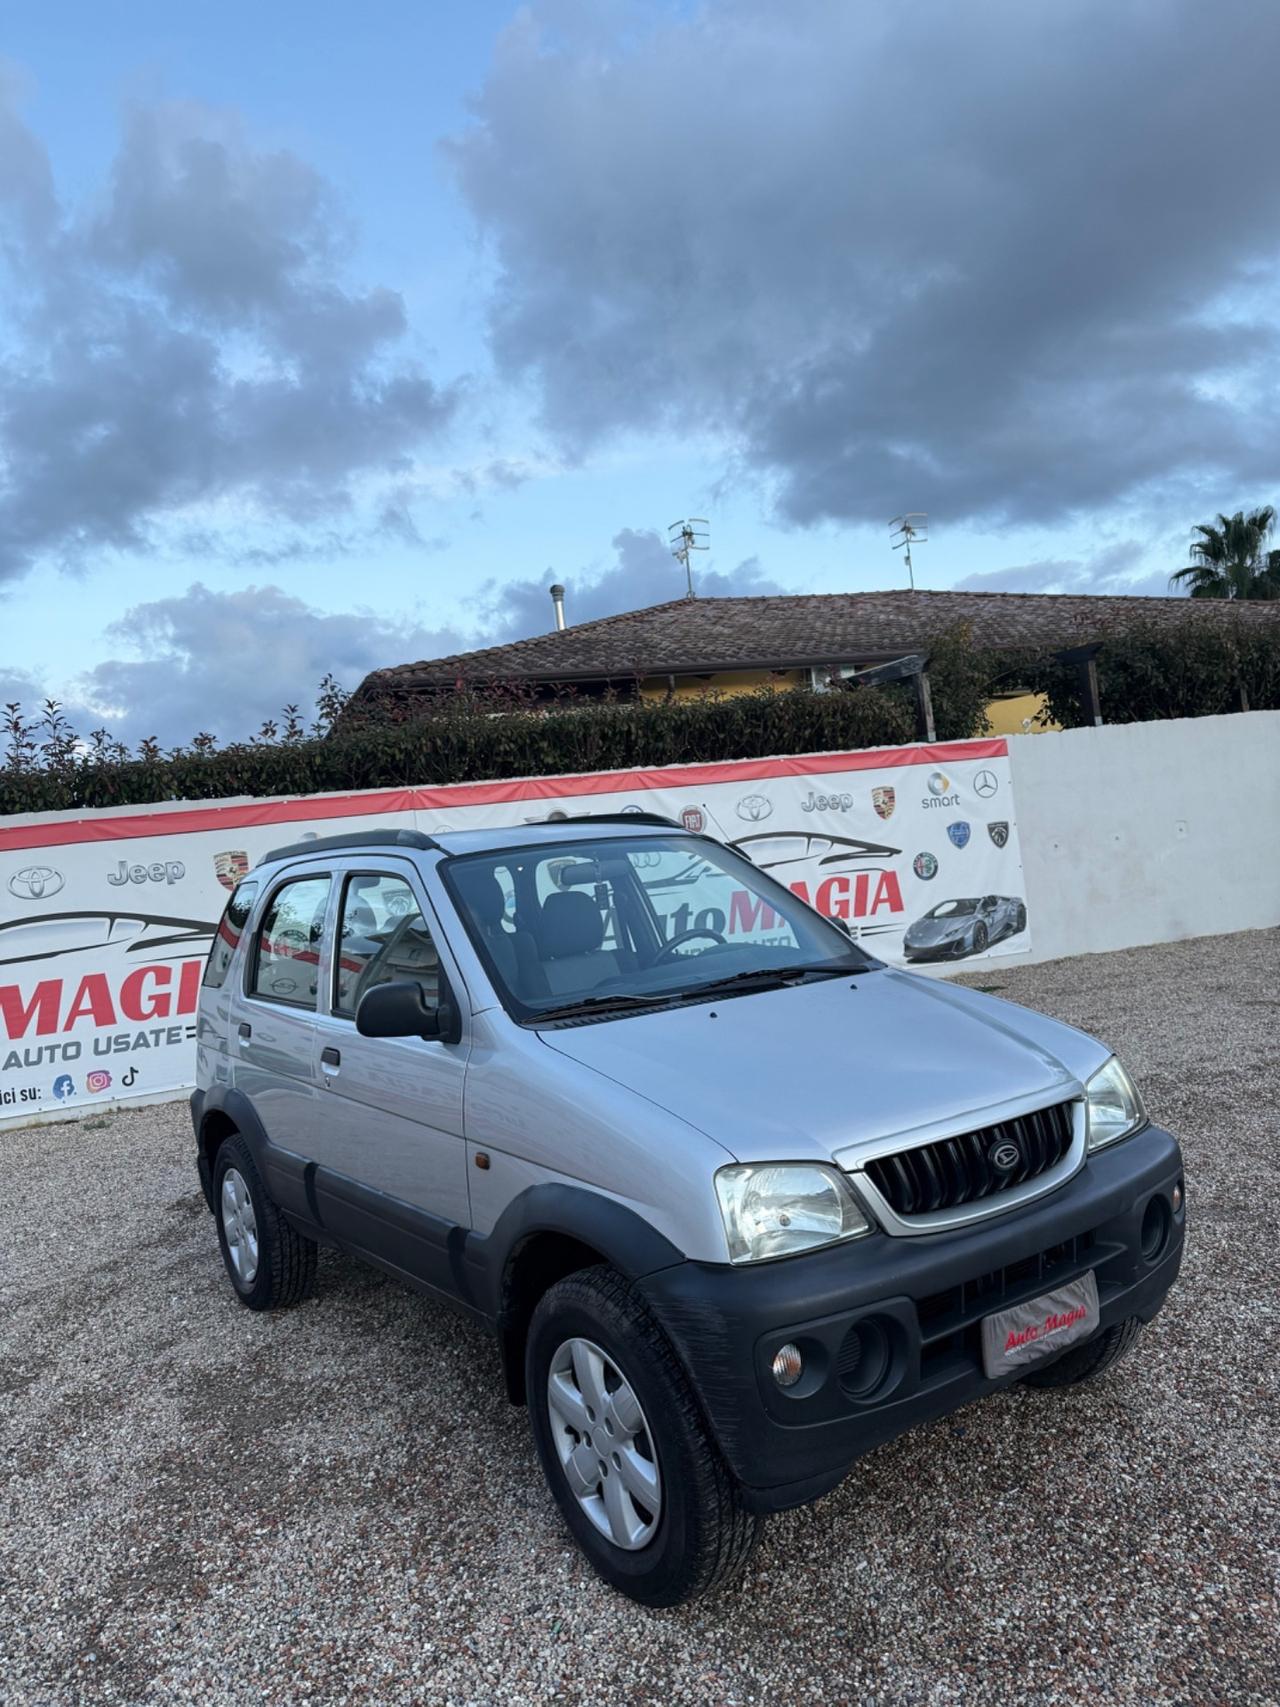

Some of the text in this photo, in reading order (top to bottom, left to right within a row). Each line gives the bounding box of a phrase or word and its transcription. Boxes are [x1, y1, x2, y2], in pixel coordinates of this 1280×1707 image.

[801, 792, 854, 813] Jeep
[921, 794, 960, 809] smart
[107, 860, 186, 886] Jeep
[0, 960, 202, 1040] MAGI
[2, 1025, 183, 1071] AUTO USATE
[0, 1086, 42, 1105] ici su:
[1004, 1326, 1038, 1350] Auto
